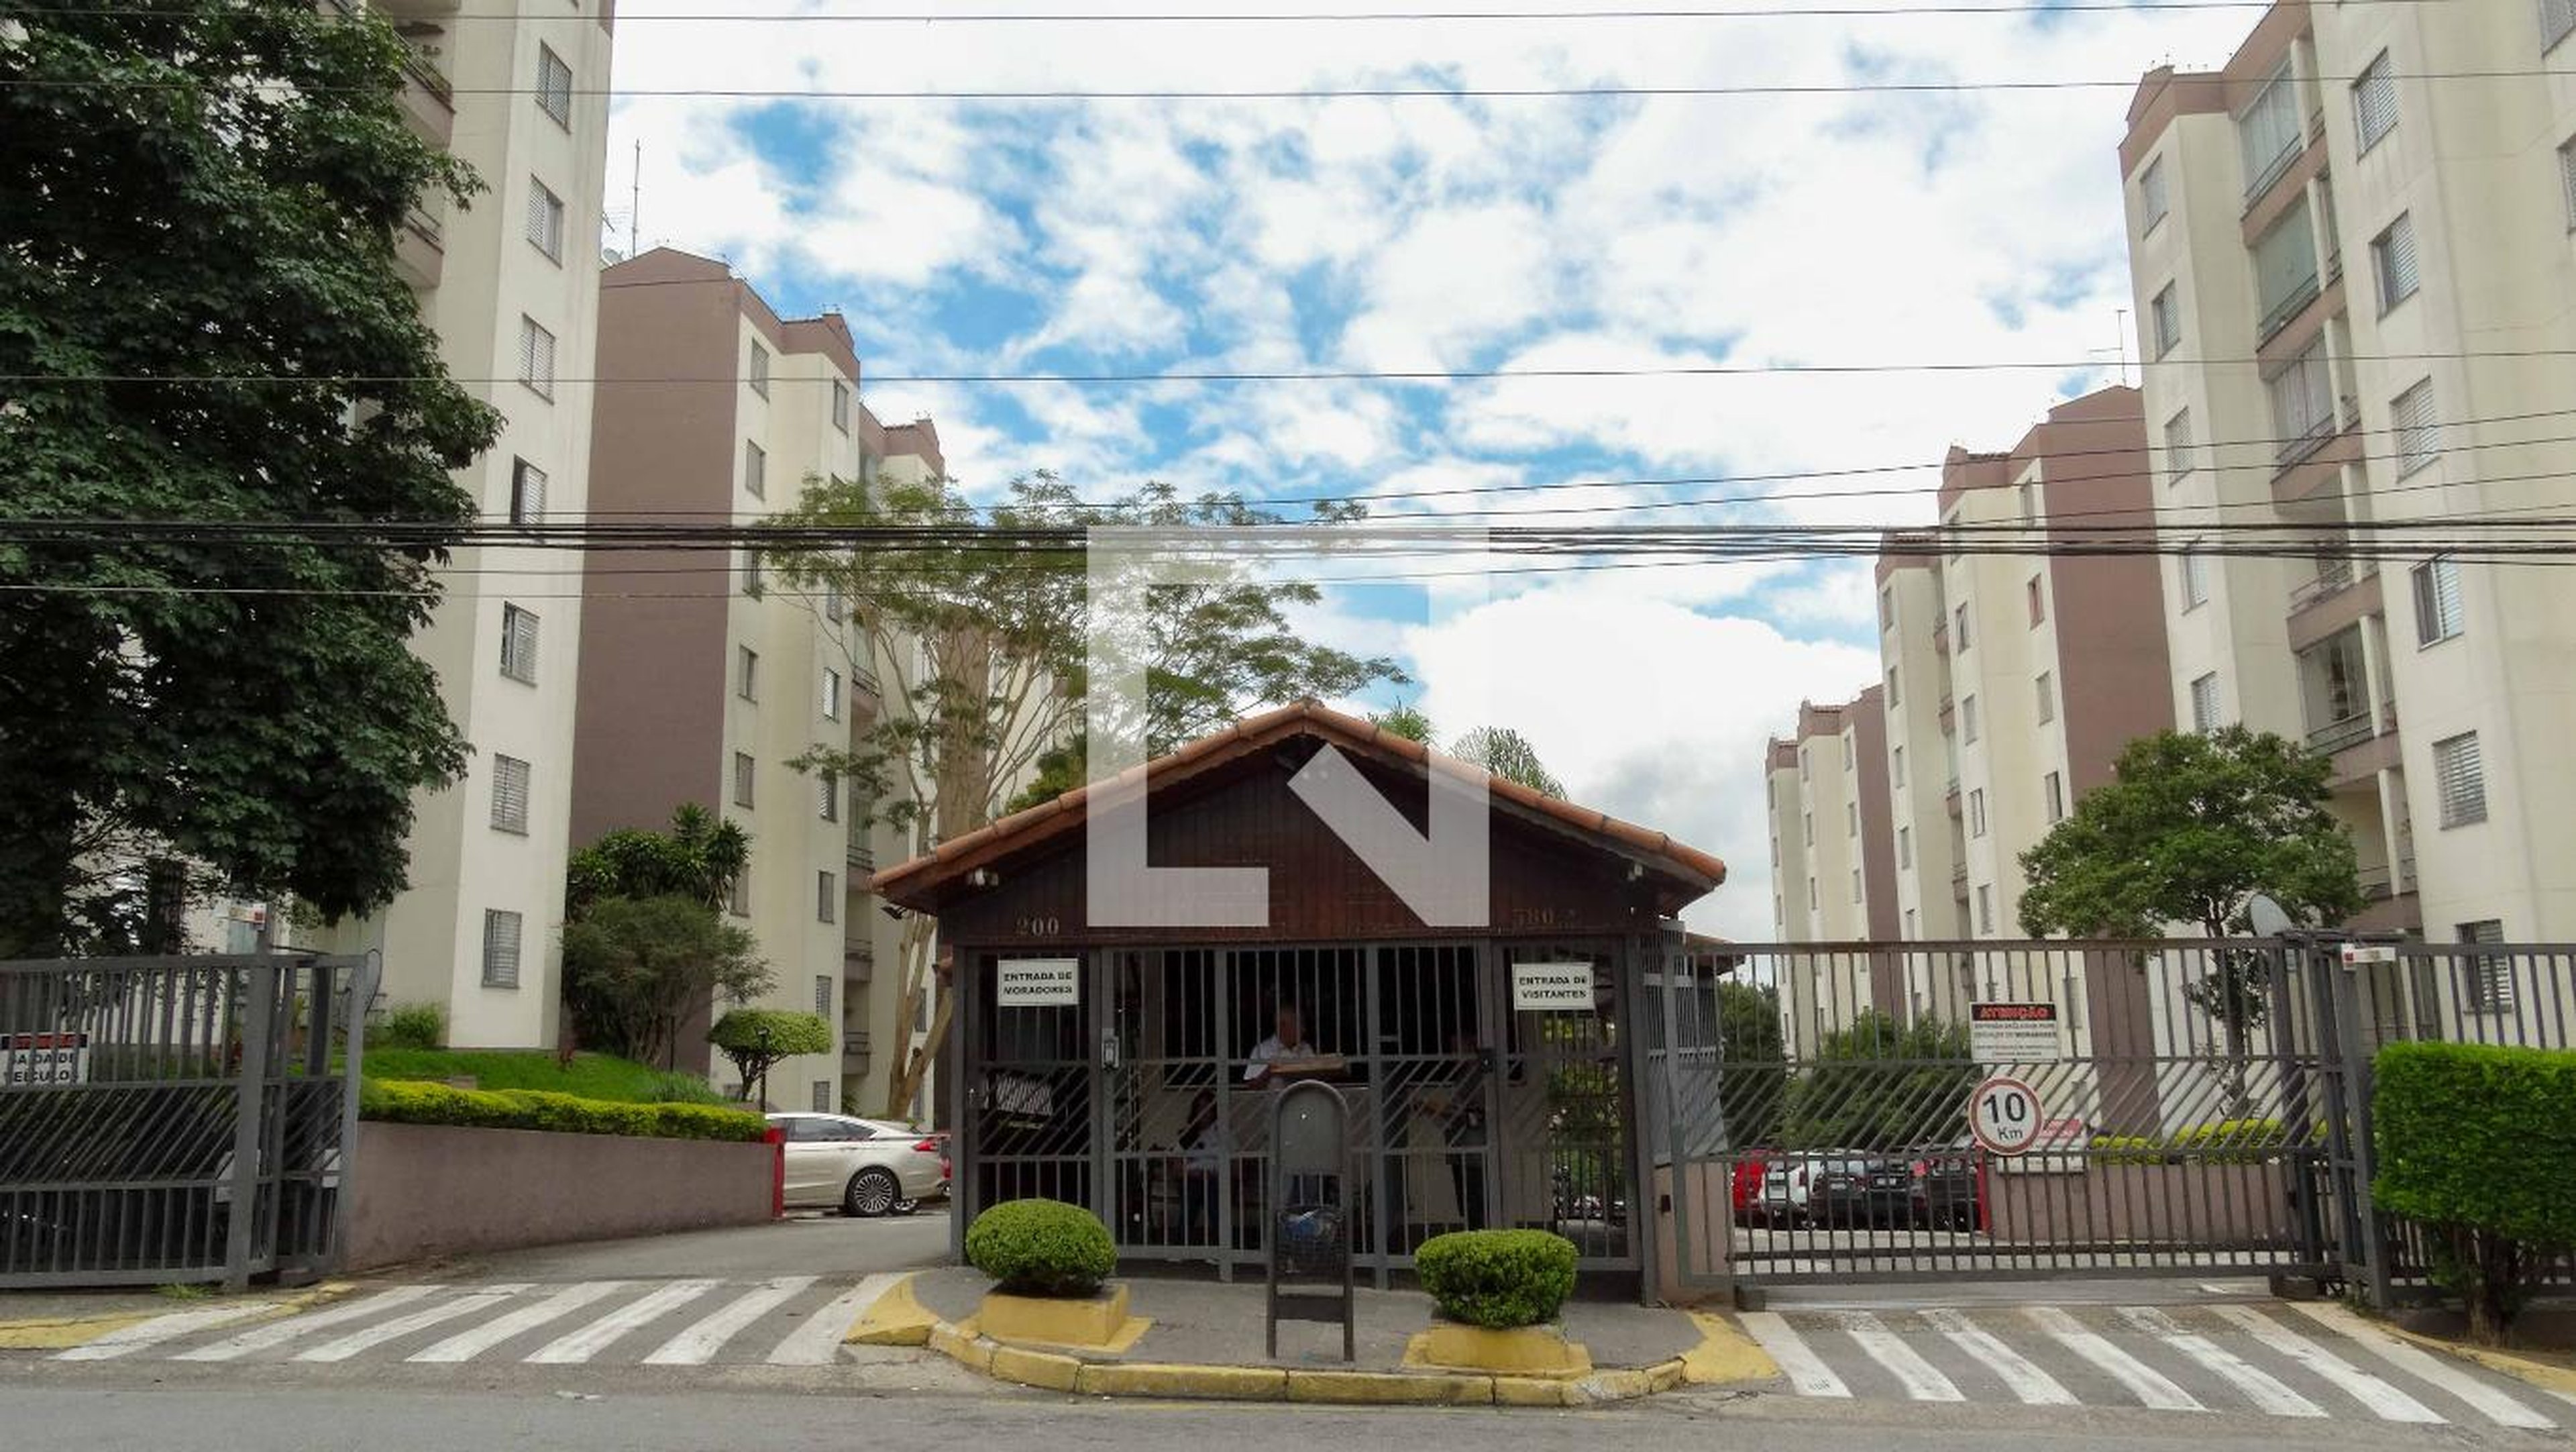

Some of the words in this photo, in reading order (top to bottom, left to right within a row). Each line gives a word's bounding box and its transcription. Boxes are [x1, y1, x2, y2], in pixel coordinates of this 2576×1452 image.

[1016, 917, 1059, 936] 200
[1004, 973, 1055, 982] ENTRADA
[1058, 972, 1072, 980] DE
[1519, 976, 1570, 986] ENTRADA
[1573, 976, 1587, 984] DE
[1003, 986, 1072, 995] MORADORES
[1521, 990, 1587, 999] VISITANTES
[9, 1053, 52, 1064] ADA
[1982, 1092, 2026, 1124] 10
[1997, 1127, 2023, 1140] Km
